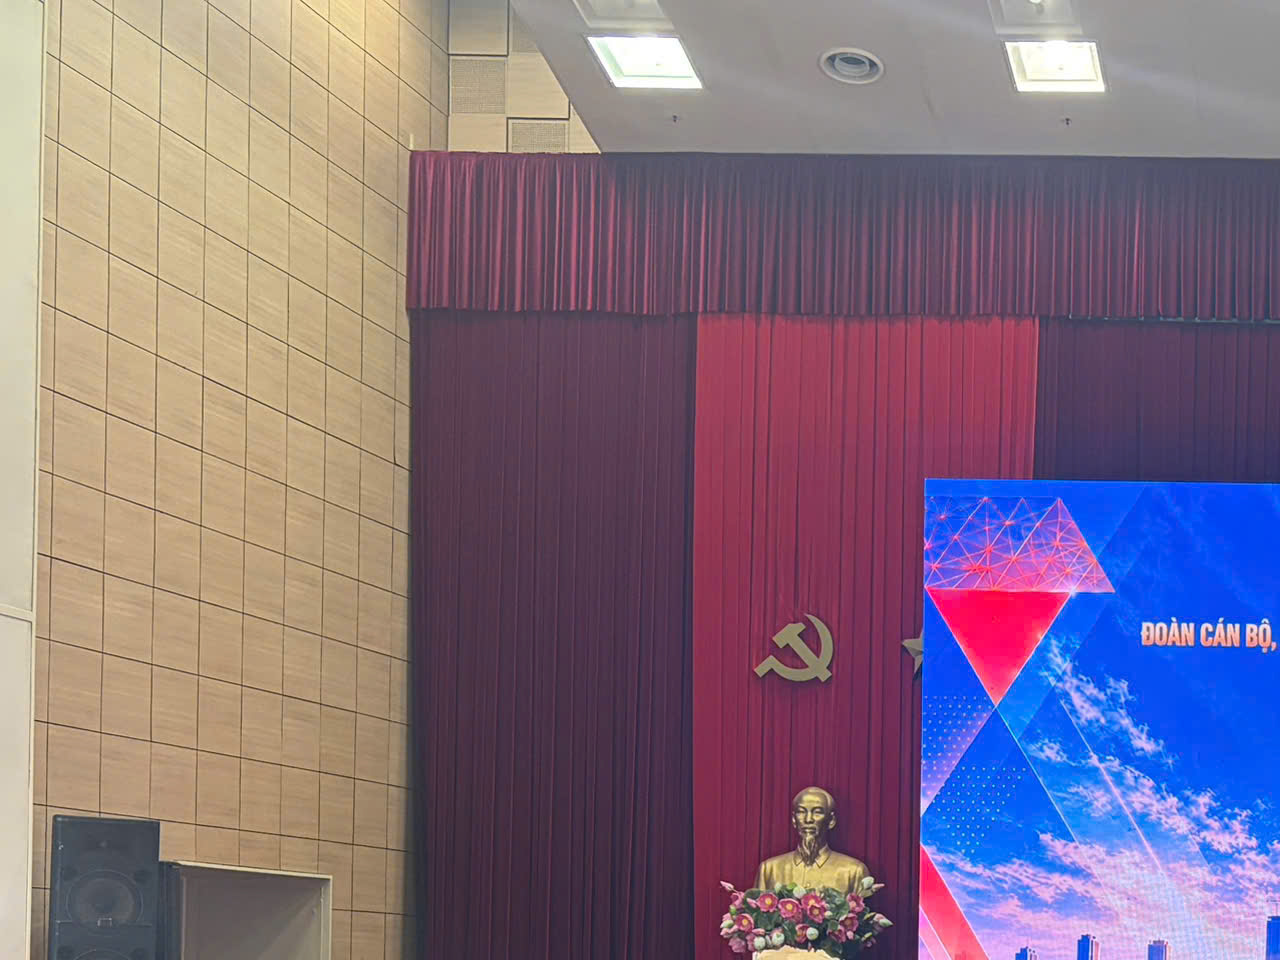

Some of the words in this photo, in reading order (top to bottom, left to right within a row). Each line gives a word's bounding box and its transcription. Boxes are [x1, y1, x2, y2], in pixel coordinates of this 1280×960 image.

[1141, 617, 1195, 647] ĐOÀN
[1200, 617, 1240, 648] CÁN
[1246, 618, 1276, 653] BỘ,
